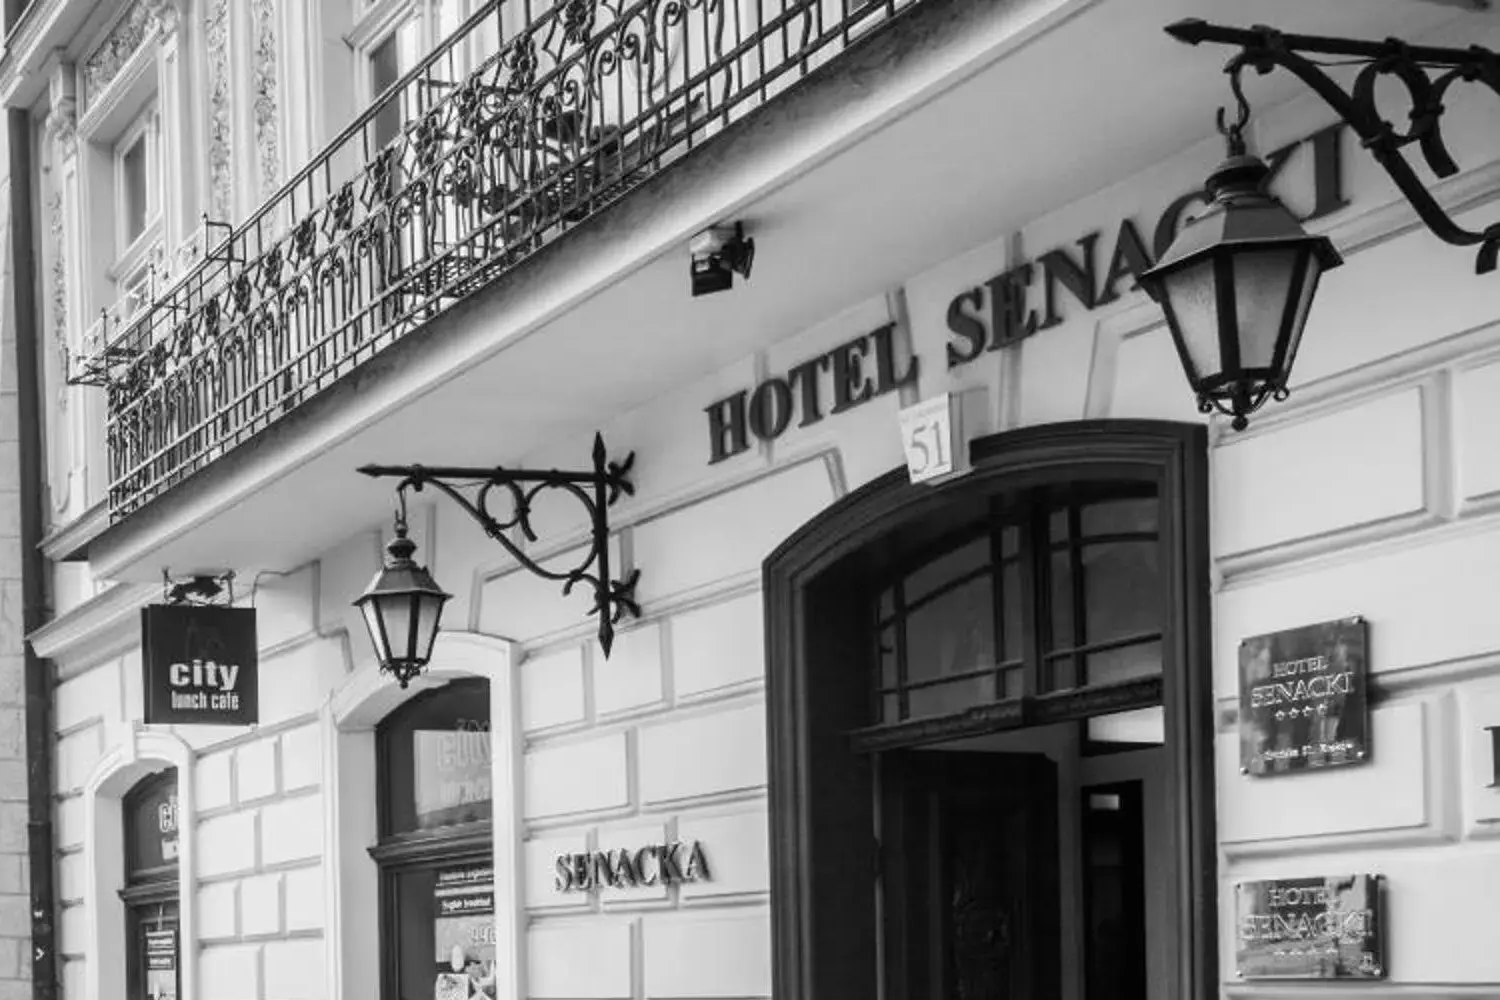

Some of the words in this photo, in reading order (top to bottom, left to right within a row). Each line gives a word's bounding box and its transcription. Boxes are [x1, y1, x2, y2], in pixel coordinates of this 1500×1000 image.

[703, 320, 920, 465] HOTEL
[946, 124, 1352, 370] SENACI
[911, 421, 949, 474] 51
[169, 659, 239, 691] city
[1272, 655, 1329, 679] HOTEL
[171, 690, 207, 709] lunch
[1251, 671, 1356, 708] SENACKI
[555, 840, 714, 892] SENACKA
[1267, 886, 1341, 907] HOTEL
